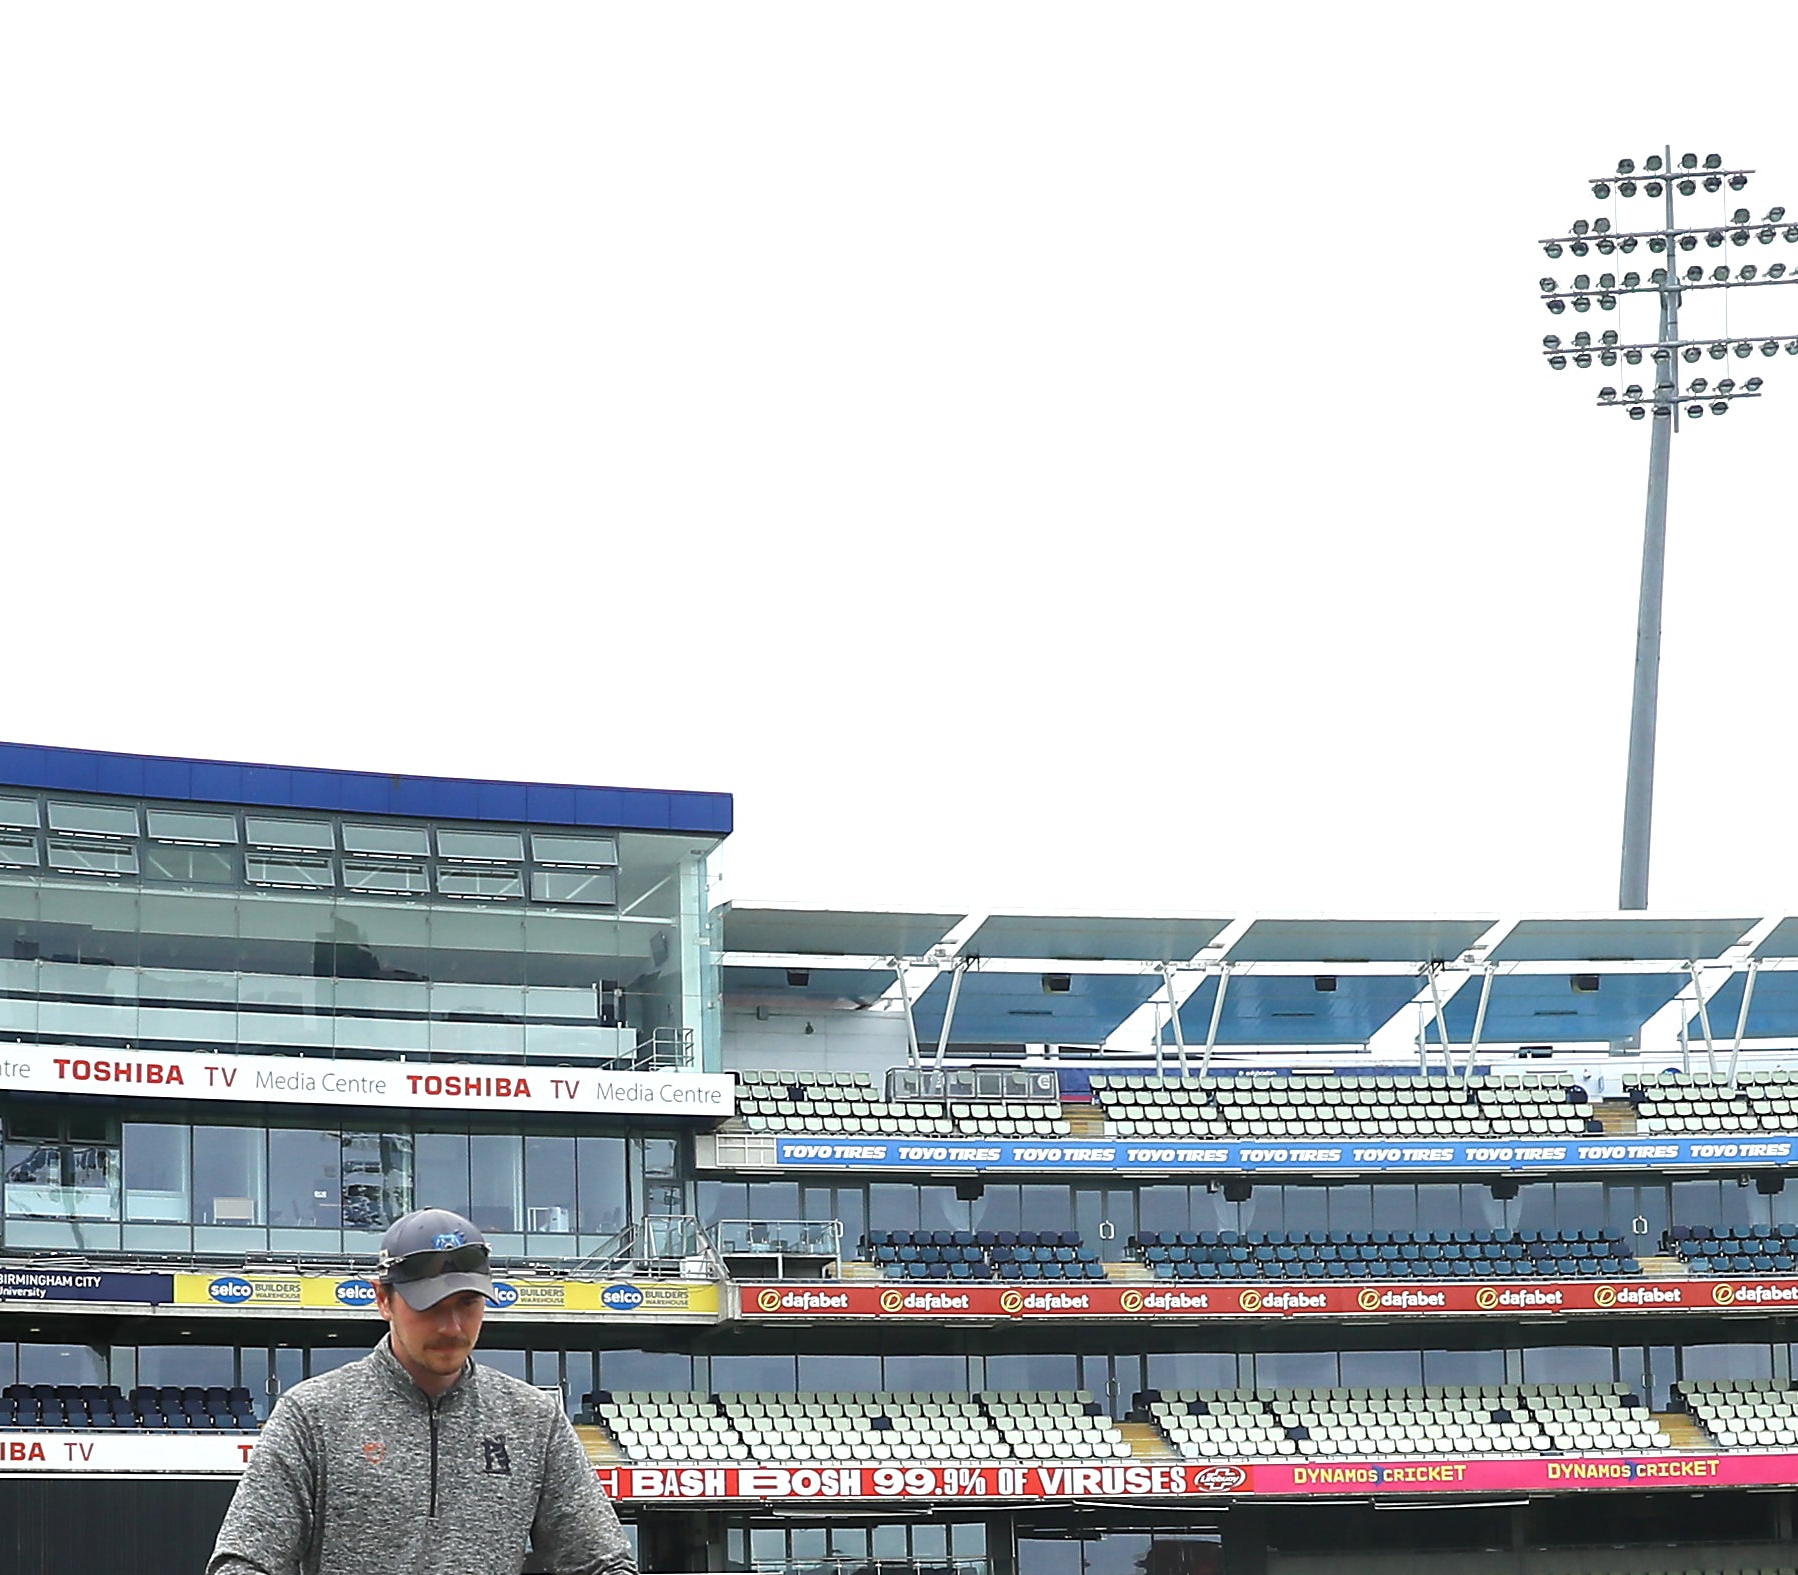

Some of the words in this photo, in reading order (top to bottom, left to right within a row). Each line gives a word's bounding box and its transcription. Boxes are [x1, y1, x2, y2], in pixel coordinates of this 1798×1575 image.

[53, 1058, 185, 1085] TOSHIBA
[204, 1066, 237, 1088] TV
[256, 1070, 316, 1093] Media
[322, 1073, 386, 1095] Centre
[407, 1075, 532, 1098] TOSHIBA
[550, 1080, 579, 1100] TV
[597, 1083, 654, 1103] Media
[659, 1085, 722, 1104] Centre
[782, 1145, 832, 1159] TOYO
[832, 1146, 887, 1161] TIRES
[899, 1147, 948, 1160] TOYO
[948, 1147, 1001, 1161] TIRES
[1013, 1148, 1062, 1161] TOYO
[1062, 1148, 1115, 1162] TIRES
[1127, 1149, 1177, 1162] TOYO
[1176, 1149, 1228, 1162] TIRES
[1240, 1149, 1289, 1162] TOYO
[1289, 1148, 1341, 1162] TIRES
[1353, 1149, 1402, 1162] TOYO
[1402, 1148, 1454, 1161] TIRES
[1465, 1148, 1514, 1161] TOYO
[1514, 1147, 1566, 1161] TIRES
[1578, 1147, 1626, 1159] TOYO
[1626, 1145, 1678, 1159] TIRES
[1690, 1145, 1738, 1158] TOYO
[1739, 1143, 1791, 1157] TIRES
[75, 1276, 102, 1288] CITY
[211, 1282, 251, 1297] selco
[337, 1284, 376, 1299] selco
[603, 1290, 641, 1304] selco
[1381, 1290, 1445, 1308] dafabet
[1499, 1290, 1563, 1306] dafabet
[1617, 1287, 1681, 1305] dafabet
[1735, 1284, 1798, 1303] dafabet
[781, 1292, 848, 1311] dafabet
[904, 1293, 969, 1311] dafabet
[1024, 1293, 1089, 1311] dafabet
[1144, 1293, 1208, 1310] dafabet
[1262, 1292, 1326, 1310] dafabet
[64, 1443, 95, 1462] TV
[1294, 1467, 1378, 1484] DYNAMOS
[1382, 1464, 1467, 1482] CRICKET
[1548, 1462, 1631, 1480] DYNAMOS
[1636, 1460, 1720, 1479] CRICKET
[632, 1469, 725, 1496] BASH
[738, 1469, 861, 1496] BOSH
[873, 1468, 986, 1496] 99.9%
[998, 1468, 1029, 1494] OF
[1037, 1466, 1186, 1494] VIRUSES
